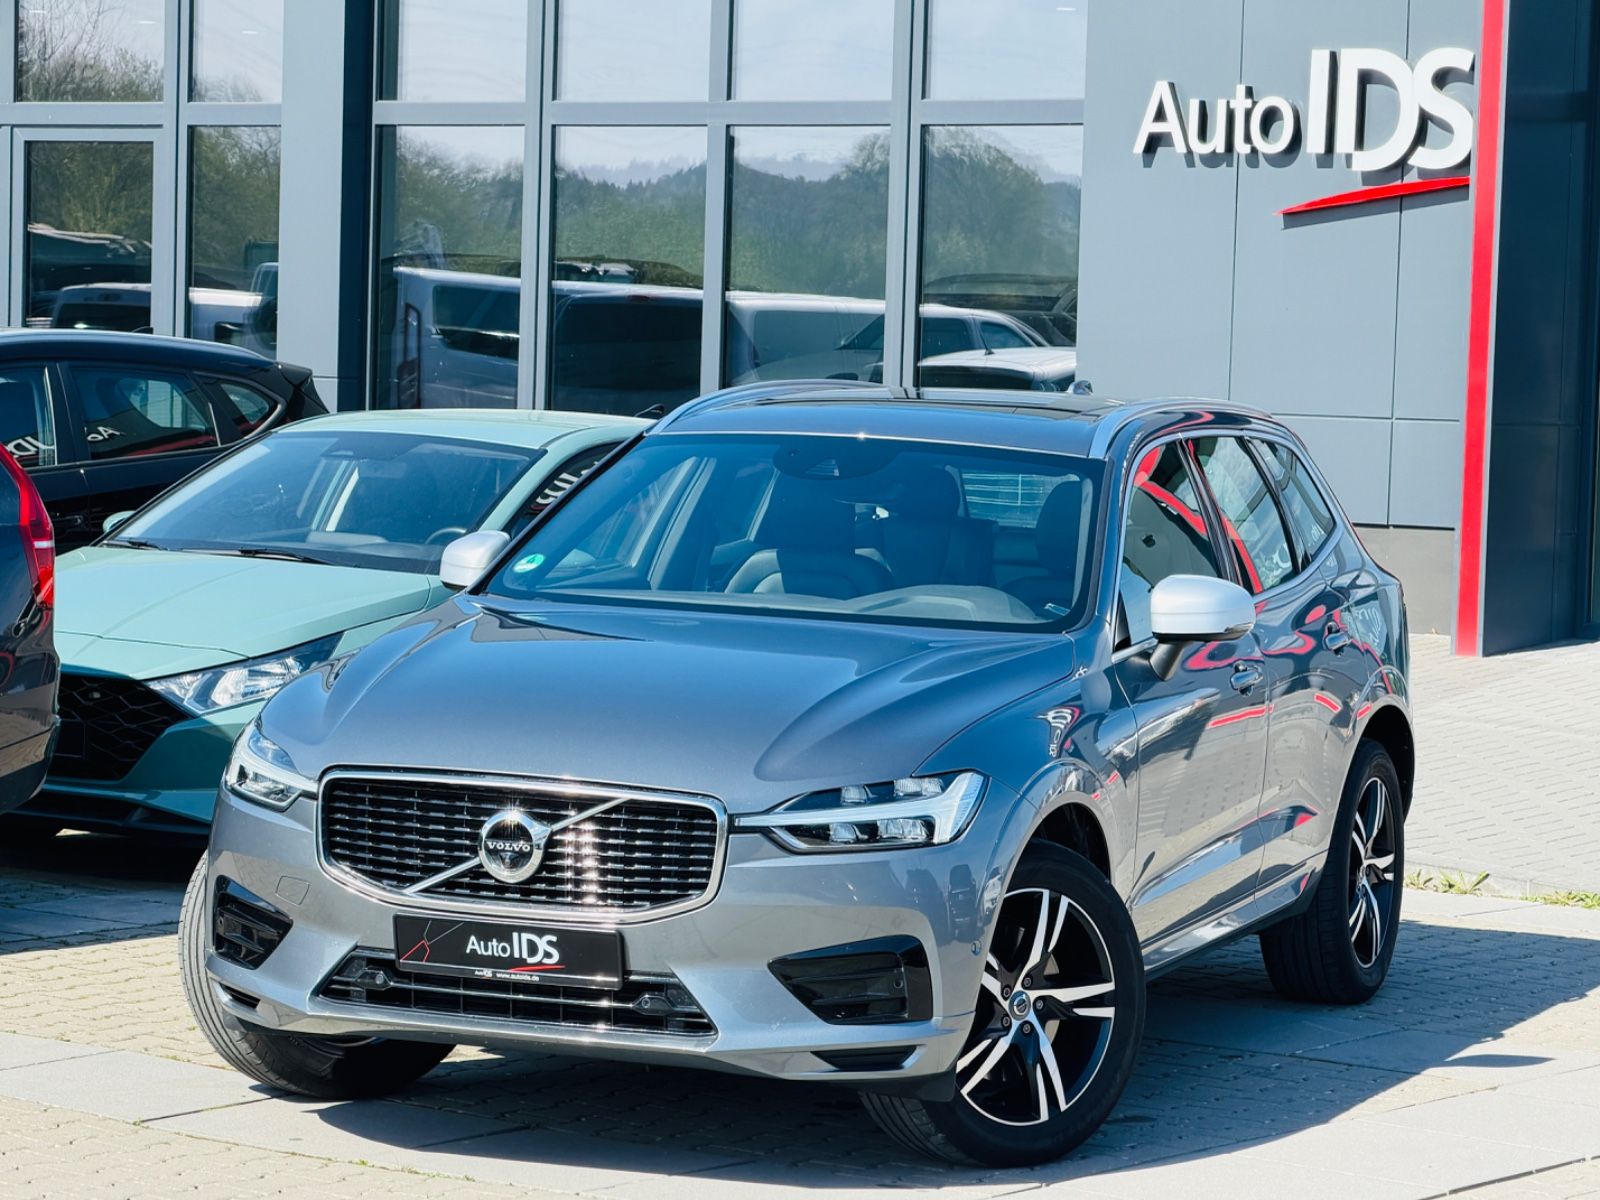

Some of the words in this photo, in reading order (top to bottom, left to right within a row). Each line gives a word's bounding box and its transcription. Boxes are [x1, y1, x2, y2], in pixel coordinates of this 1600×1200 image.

[1132, 80, 1295, 156] Auto
[1305, 47, 1475, 172] IDS
[486, 841, 531, 852] VOLVO
[465, 934, 511, 958] Auto
[512, 931, 560, 964] IDS
